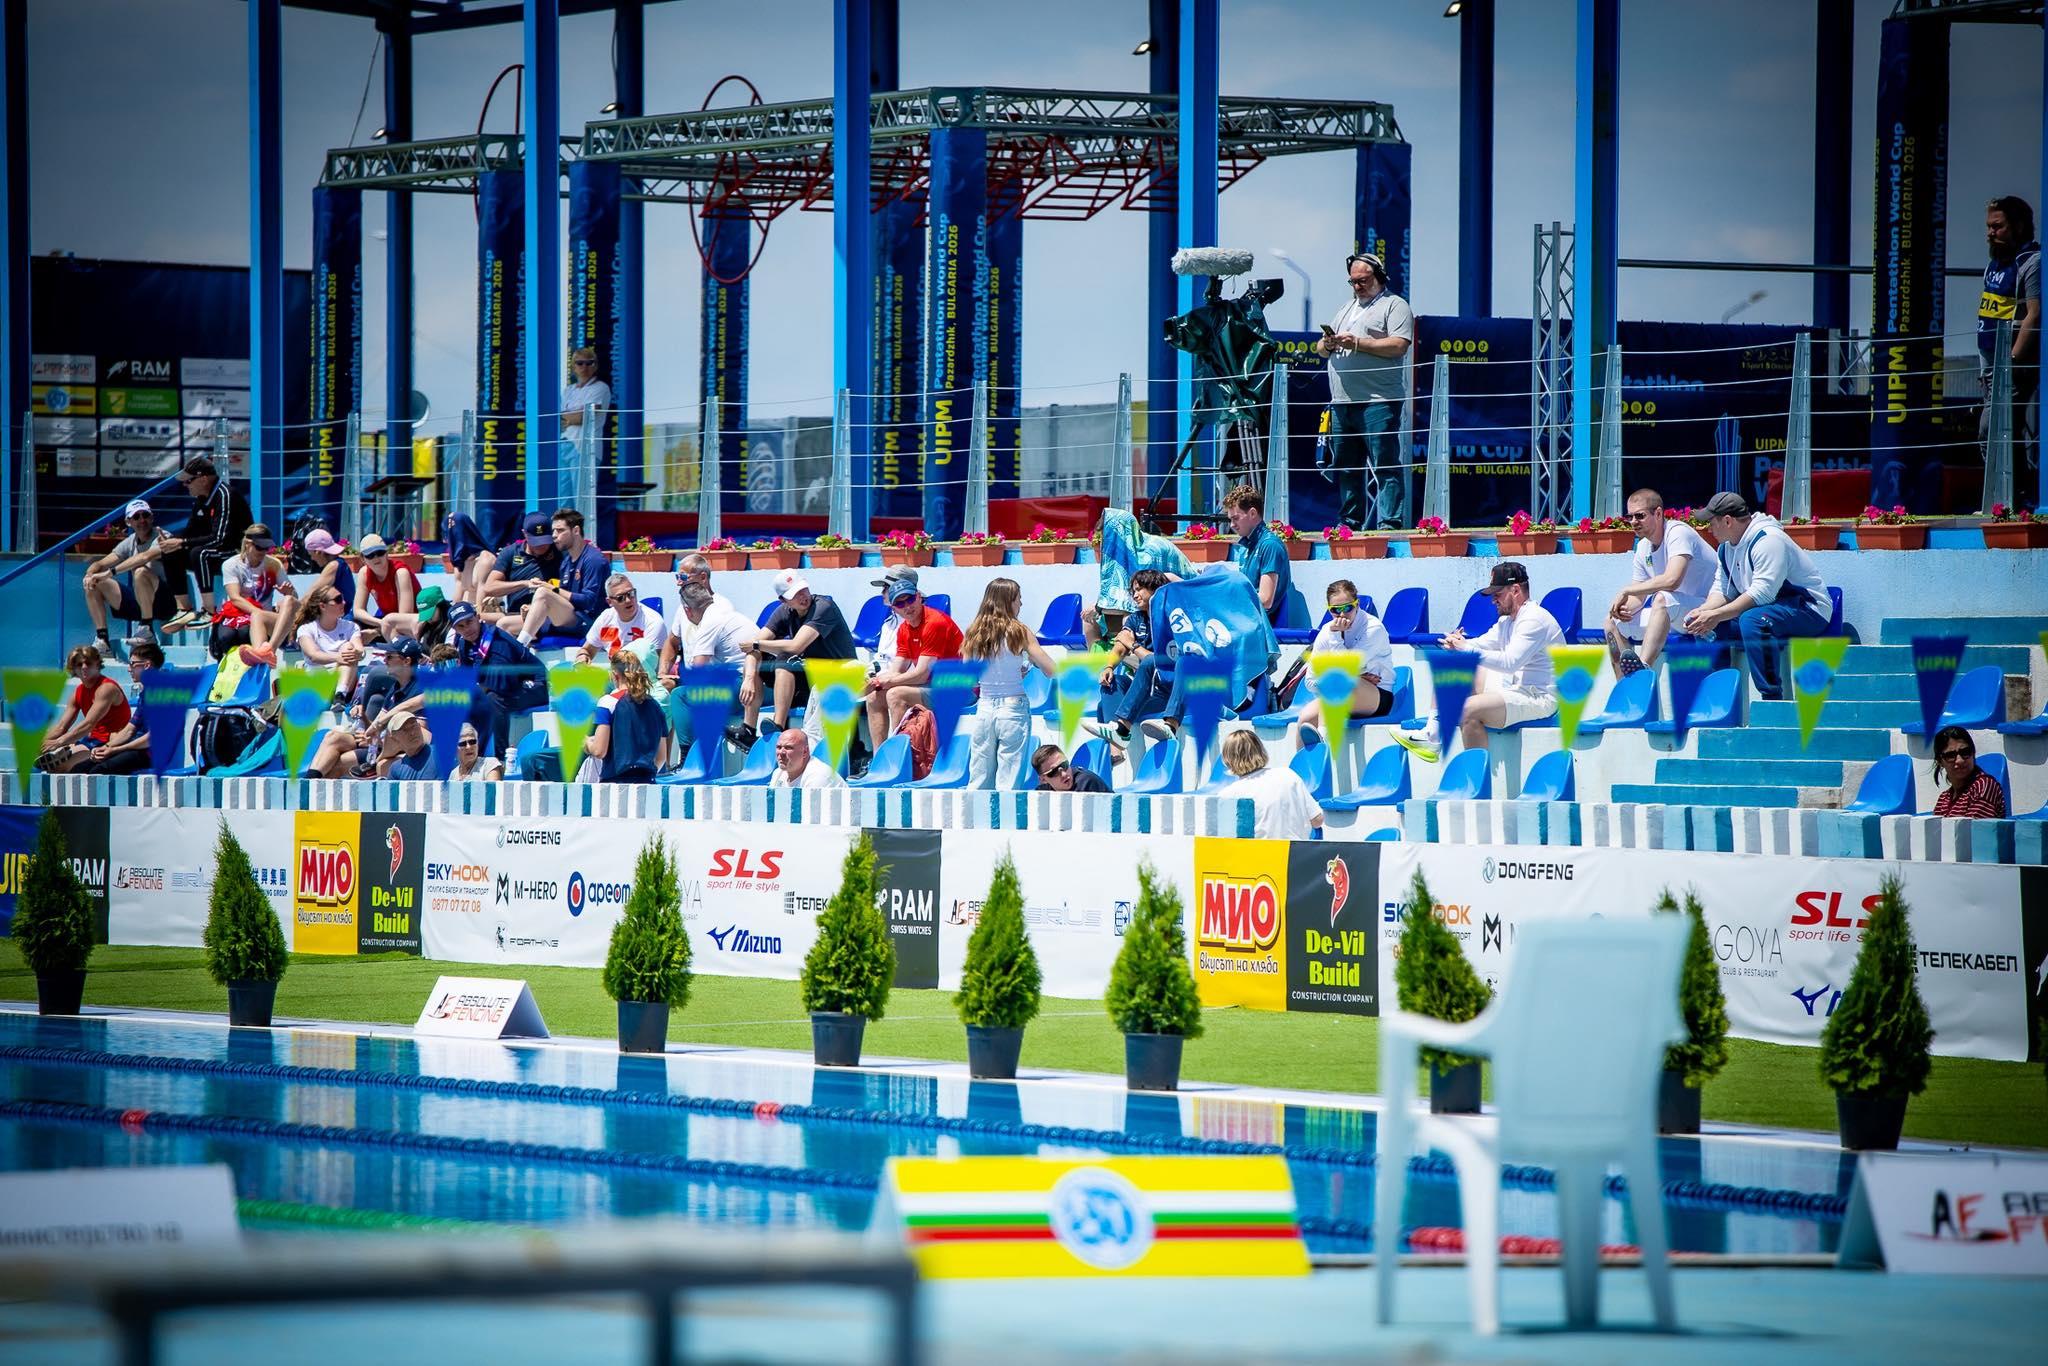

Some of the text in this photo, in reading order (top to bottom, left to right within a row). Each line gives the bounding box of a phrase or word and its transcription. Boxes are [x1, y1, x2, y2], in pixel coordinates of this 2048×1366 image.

[1902, 136, 1915, 172] 2026
[1901, 176, 1914, 248] BULGARIA
[947, 225, 958, 255] 2026
[1887, 122, 1905, 333] Pentathlon World Cup
[577, 240, 588, 270] Cup
[318, 263, 329, 291] Cup
[328, 273, 337, 301] 2026
[492, 260, 503, 289] 2026
[894, 275, 903, 302] 2026
[990, 267, 1000, 295] 2026
[576, 274, 586, 319] World
[586, 252, 597, 338] BULGARIA 2026
[718, 288, 727, 314] 2026
[934, 213, 950, 389] Pentathlon World Cup
[946, 259, 957, 319] BULGARIA
[318, 294, 327, 336] World
[492, 291, 502, 346] BULGARIA
[990, 298, 999, 353] BULGARIA
[327, 303, 337, 357] BULGARIA
[482, 250, 494, 411] Pentathlon World Cup
[718, 317, 727, 369] BULGARIA
[131, 360, 170, 375] RAM
[1887, 346, 1908, 425] UIPM
[934, 399, 953, 465] UIPM
[318, 427, 333, 487] UIPM
[482, 420, 498, 480] UIPM
[883, 431, 900, 489] UIPM
[1475, 465, 1530, 475] BULGARIA
[1917, 656, 1958, 671] UIPM
[506, 830, 561, 846] DONGFENG
[426, 863, 490, 883] SKYHOOK
[708, 848, 784, 879] SLS
[1498, 862, 1574, 881] DONGFENG
[129, 878, 163, 891] FENCING
[372, 886, 414, 908] De-Vil
[514, 880, 558, 900] M-HERO
[706, 879, 780, 892] sport life style
[432, 898, 481, 913] 0877 07 27 08
[890, 888, 933, 922] RAM
[373, 912, 410, 934] Build
[890, 924, 932, 936] SWISS WATCHES
[1788, 929, 1824, 942] sport
[1827, 930, 1851, 943] life
[361, 938, 418, 947] CONSTRUCTION COMPANY
[1305, 929, 1365, 956] De-Vil
[1714, 924, 1783, 965] GOYA
[1236, 958, 1248, 972] на
[1250, 955, 1278, 974] хляба
[1309, 960, 1360, 987] Build
[1722, 966, 1778, 978] CLUB & RESTAURANT
[1919, 951, 2018, 972] ТЕЛЕКАБЕЛ
[1291, 990, 1374, 1004] CONSTRUCTION COMPANY
